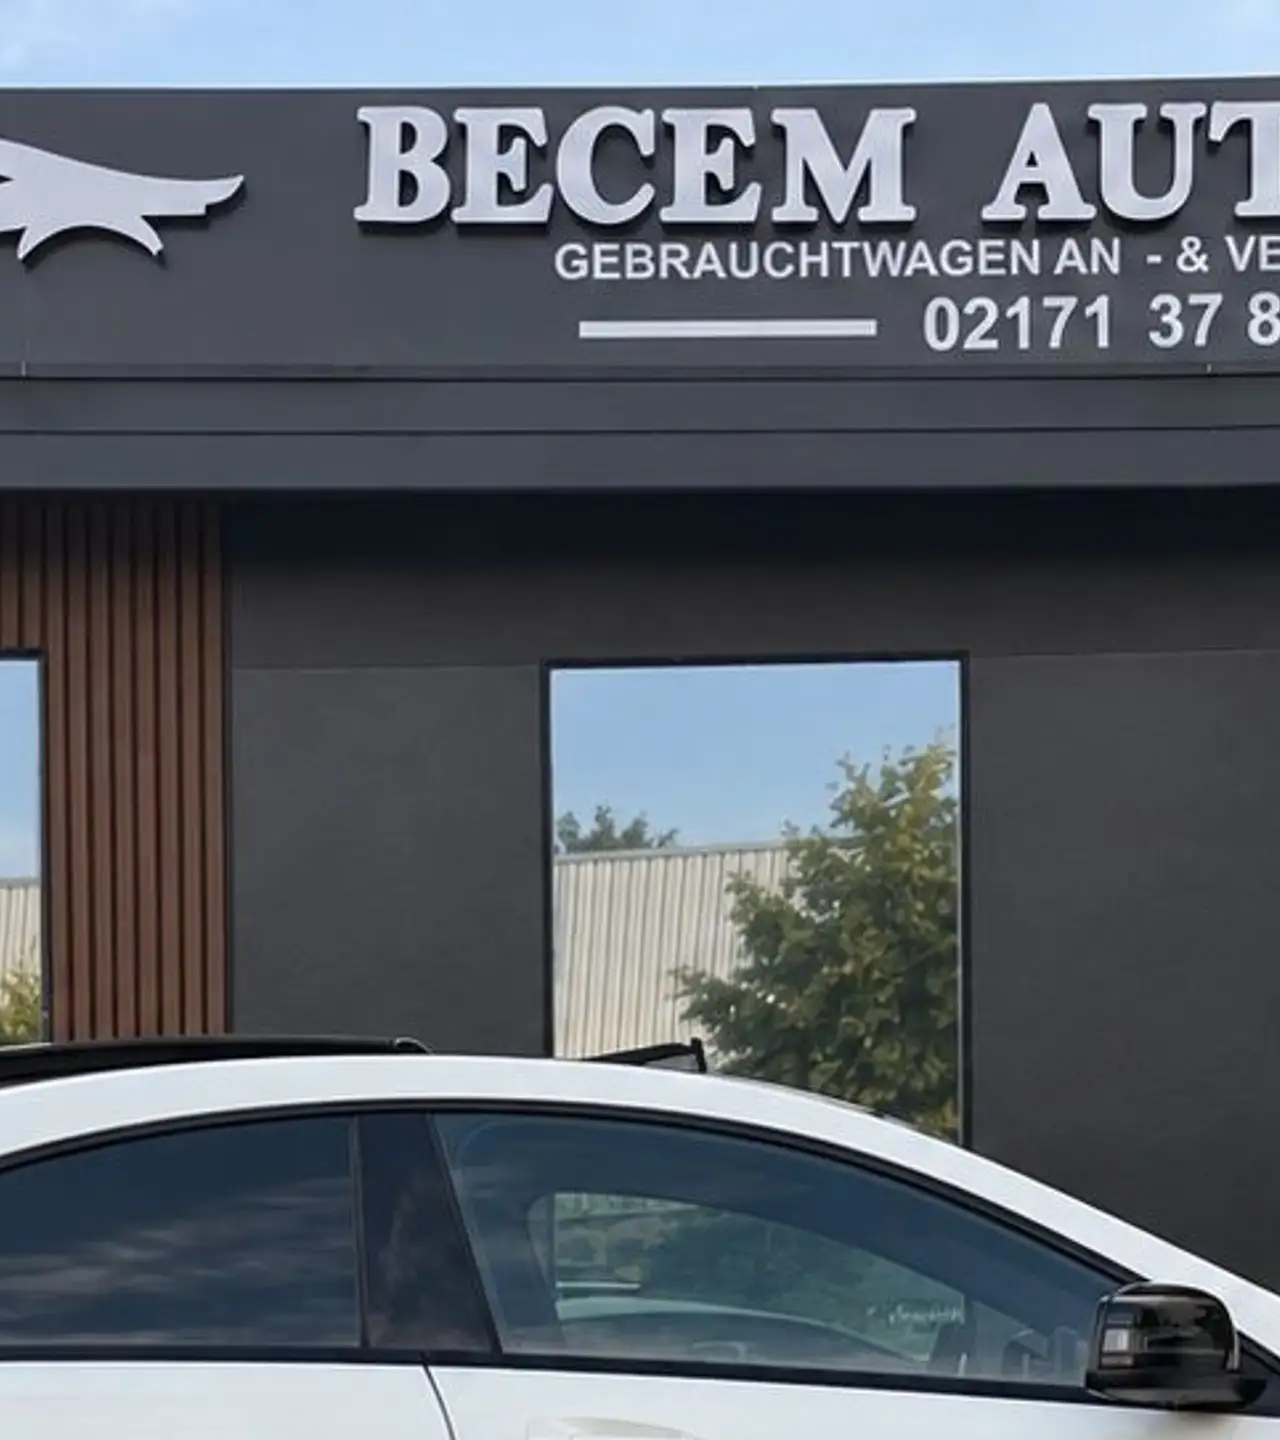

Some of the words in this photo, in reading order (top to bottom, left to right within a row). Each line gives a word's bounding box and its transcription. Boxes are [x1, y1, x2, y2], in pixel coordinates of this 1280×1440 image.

[353, 104, 918, 225] BECEM
[554, 237, 1041, 281] GEBRAUCHTWAGEN
[1052, 237, 1121, 276] AN
[1175, 235, 1211, 274] &
[923, 294, 1111, 352] 02171
[1147, 292, 1223, 348] 37
